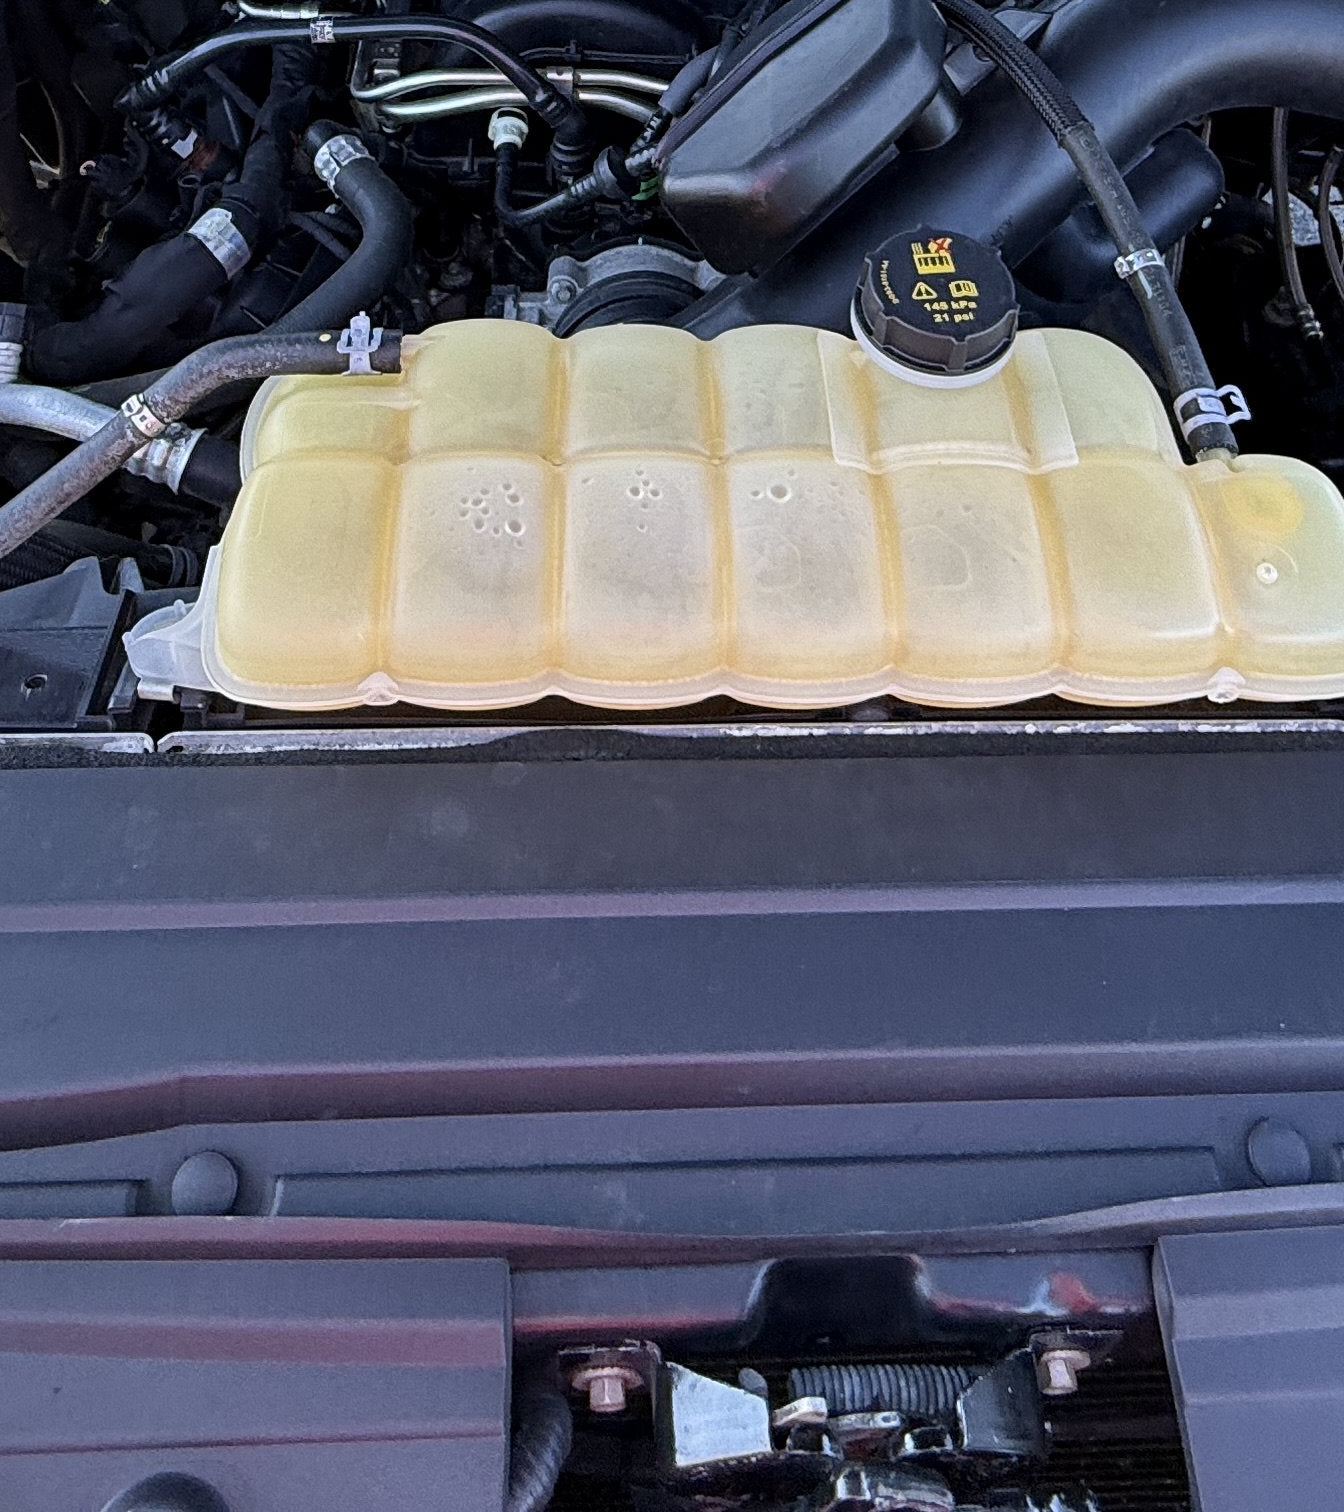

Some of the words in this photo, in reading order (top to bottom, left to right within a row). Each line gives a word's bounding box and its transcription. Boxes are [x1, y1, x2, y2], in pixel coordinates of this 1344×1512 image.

[923, 301, 948, 312] 145
[950, 300, 978, 310] kPa
[932, 312, 950, 323] 21
[953, 312, 975, 323] psi
